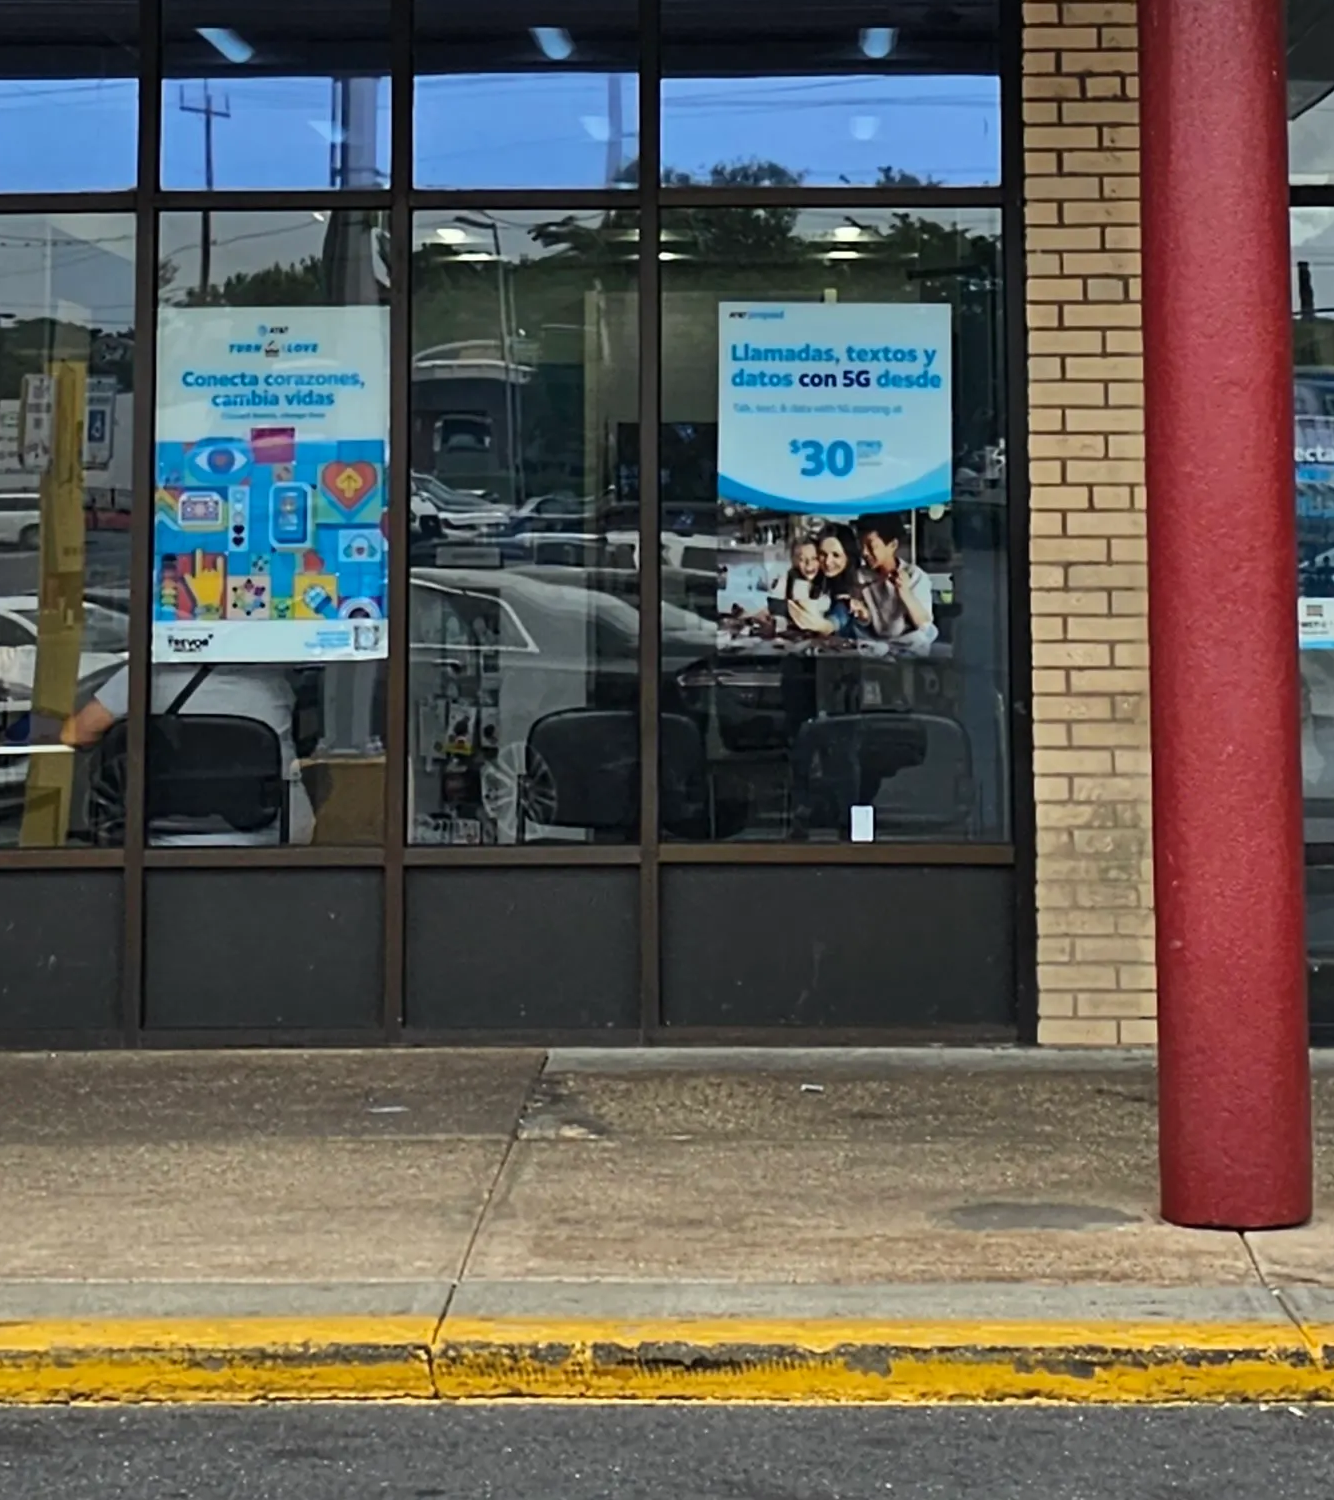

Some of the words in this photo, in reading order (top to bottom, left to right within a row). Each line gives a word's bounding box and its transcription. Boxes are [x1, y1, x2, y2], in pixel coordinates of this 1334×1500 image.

[730, 343, 841, 366] Llamadas,
[845, 345, 918, 363] textos
[922, 348, 937, 368] y
[182, 371, 260, 388] Conecta
[263, 371, 366, 390] corazones,
[731, 368, 794, 388] datos
[798, 372, 838, 388] con
[842, 370, 872, 389] 5G
[876, 368, 942, 389] desde
[211, 389, 280, 407] cambia
[283, 389, 336, 407] vidas
[788, 438, 854, 478] $30
